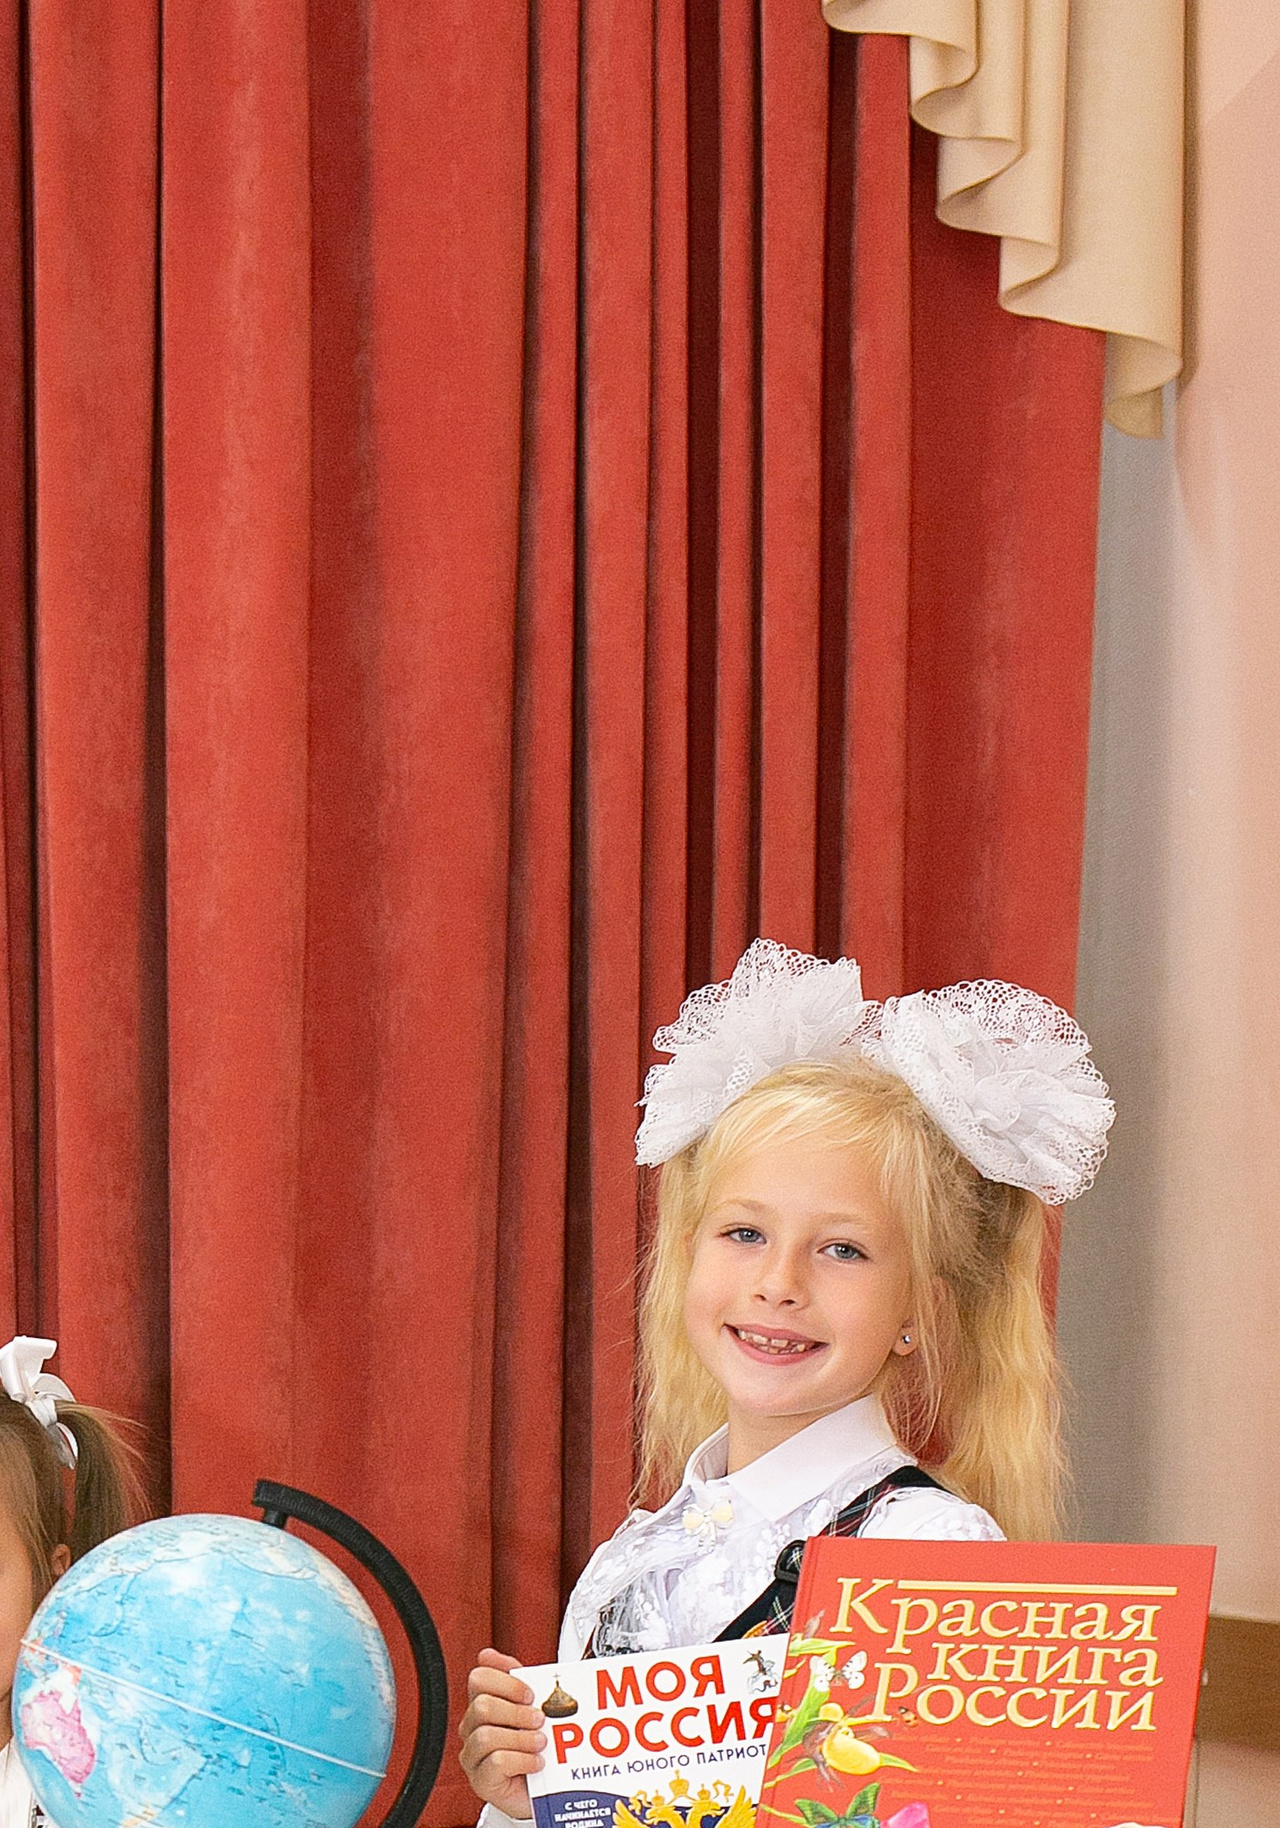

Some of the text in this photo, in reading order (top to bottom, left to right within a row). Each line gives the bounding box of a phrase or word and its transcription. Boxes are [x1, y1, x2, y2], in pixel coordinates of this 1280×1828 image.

[829, 1577, 1162, 1654] Красная
[596, 1655, 725, 1710] МОЯ
[926, 1642, 1163, 1687] книга
[866, 1662, 1156, 1731] России
[552, 1696, 777, 1763] РОССИЯ
[571, 1764, 621, 1780] КНИГА
[627, 1754, 690, 1773] ЮНОГО
[564, 1802, 572, 1811] С
